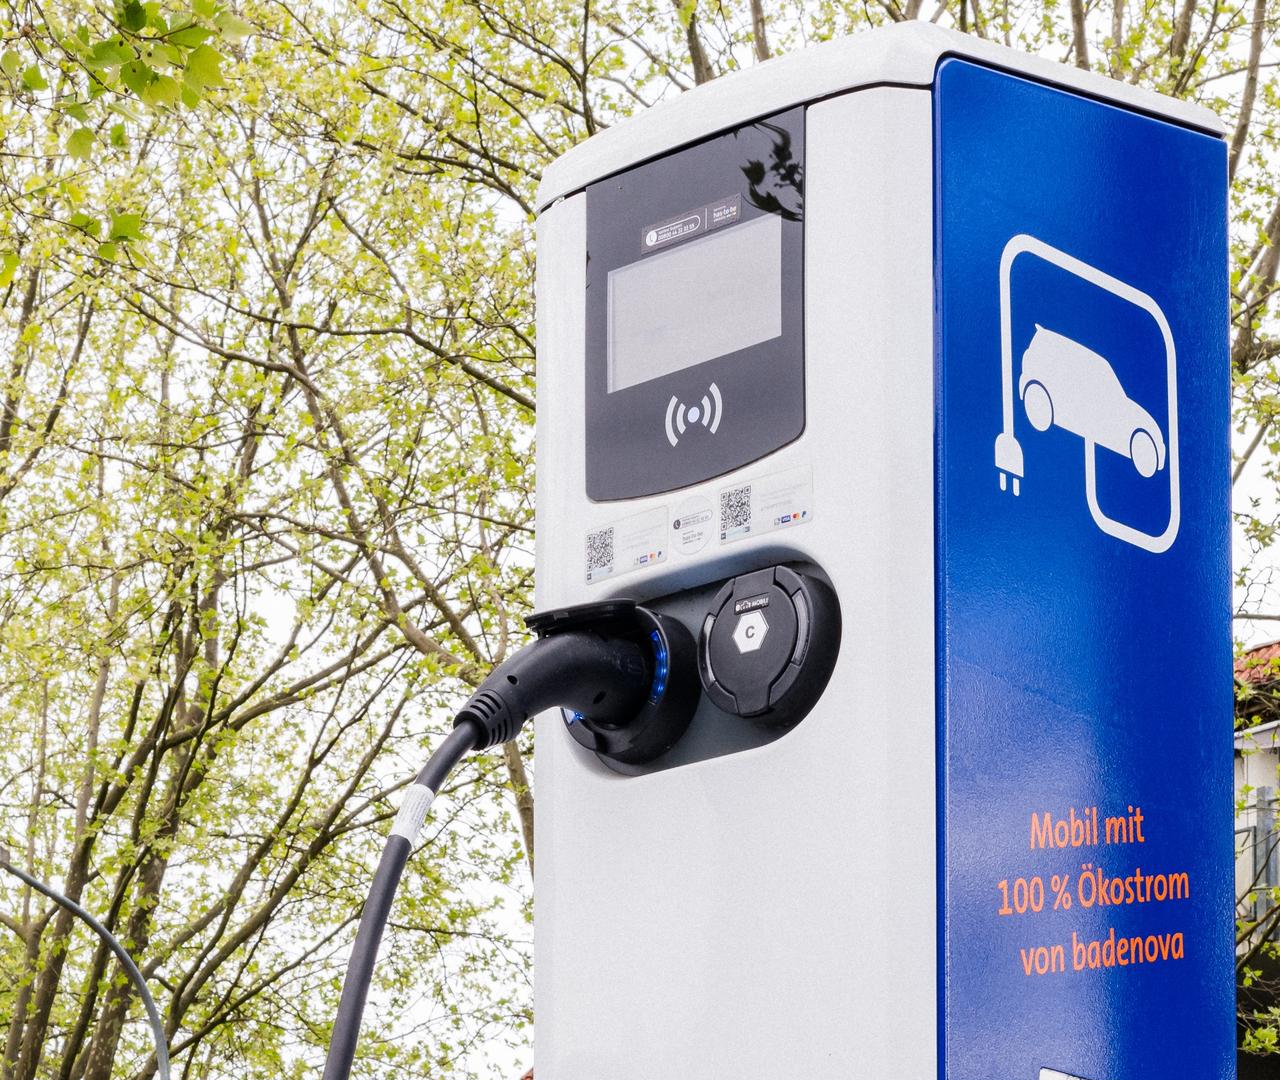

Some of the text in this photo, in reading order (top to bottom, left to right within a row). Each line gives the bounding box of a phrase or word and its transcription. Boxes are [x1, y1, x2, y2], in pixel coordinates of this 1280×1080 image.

[745, 625, 755, 639] C
[1030, 805, 1145, 850] Mobil mit
[997, 863, 1189, 915] 100 % Ökostrom
[1021, 927, 1184, 976] von badenova
